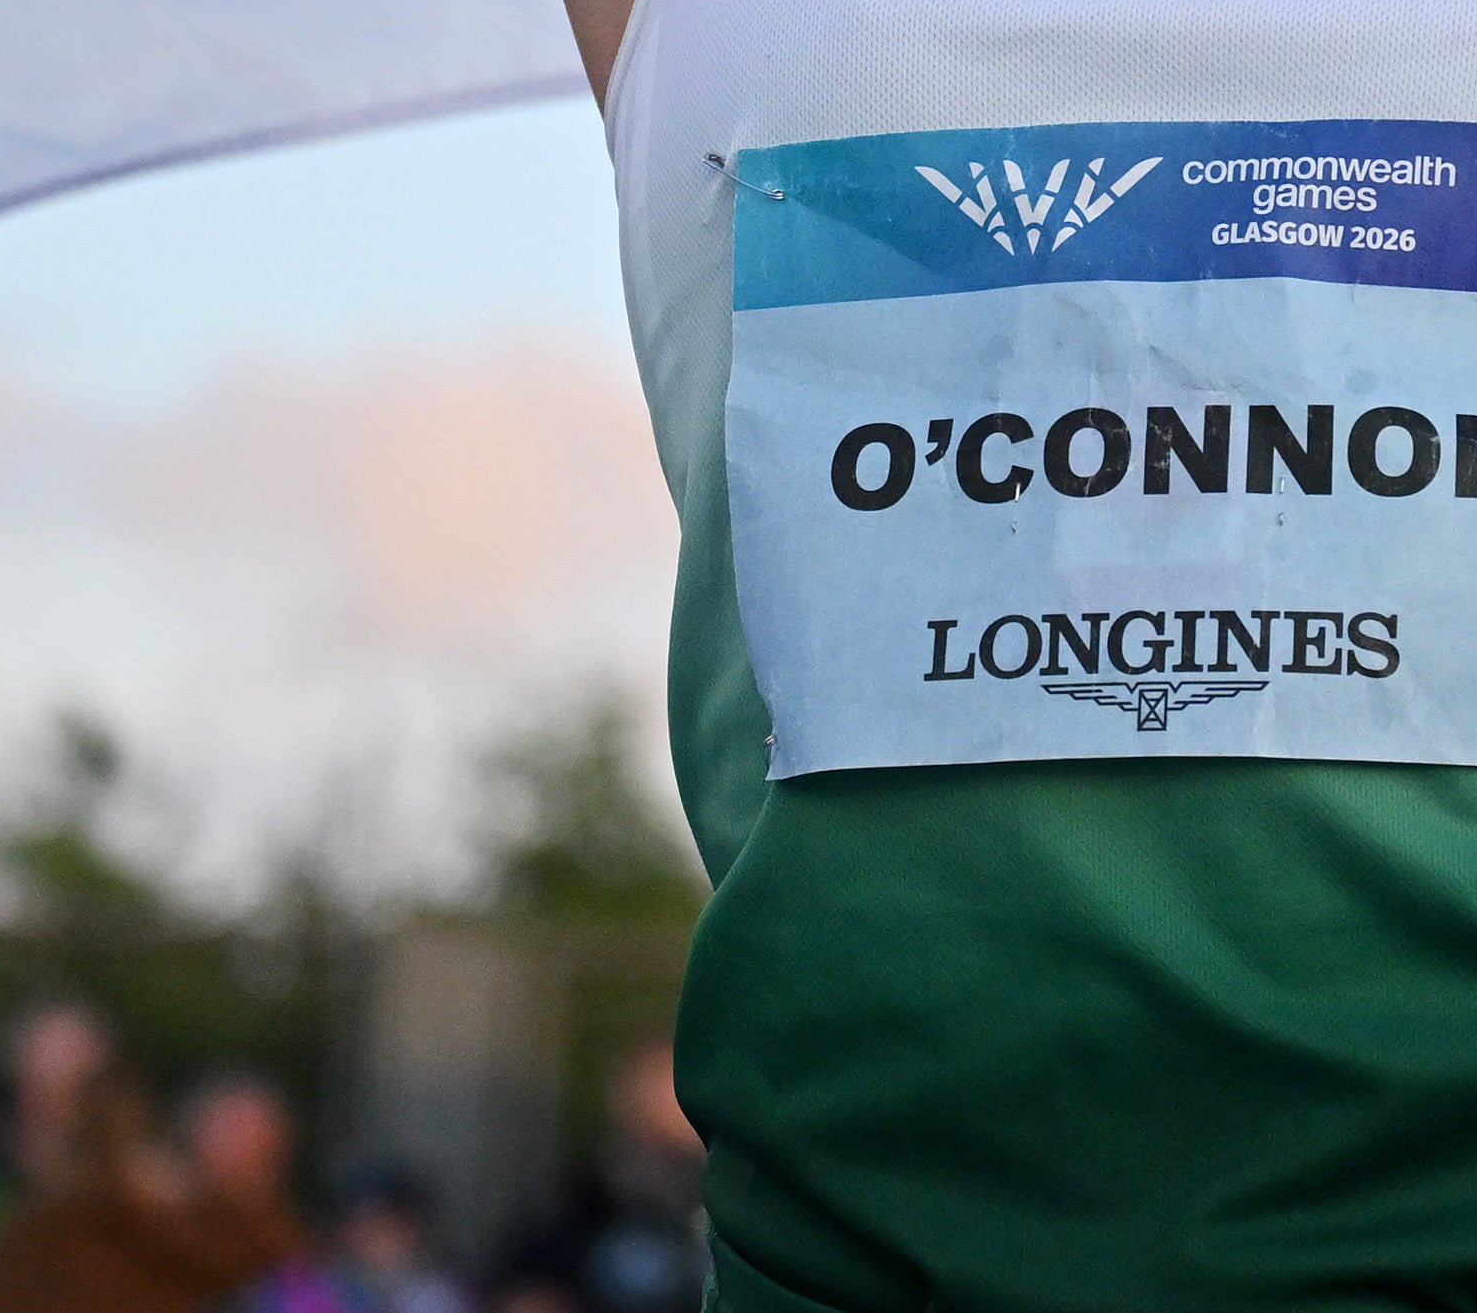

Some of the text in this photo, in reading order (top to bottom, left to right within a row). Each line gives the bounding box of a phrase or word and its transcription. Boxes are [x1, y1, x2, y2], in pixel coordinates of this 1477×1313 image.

[1181, 154, 1458, 188] commonwealth
[1252, 181, 1378, 215] games
[1210, 220, 1417, 252] GLASGOW 2026
[923, 610, 1400, 682] LONGINES
